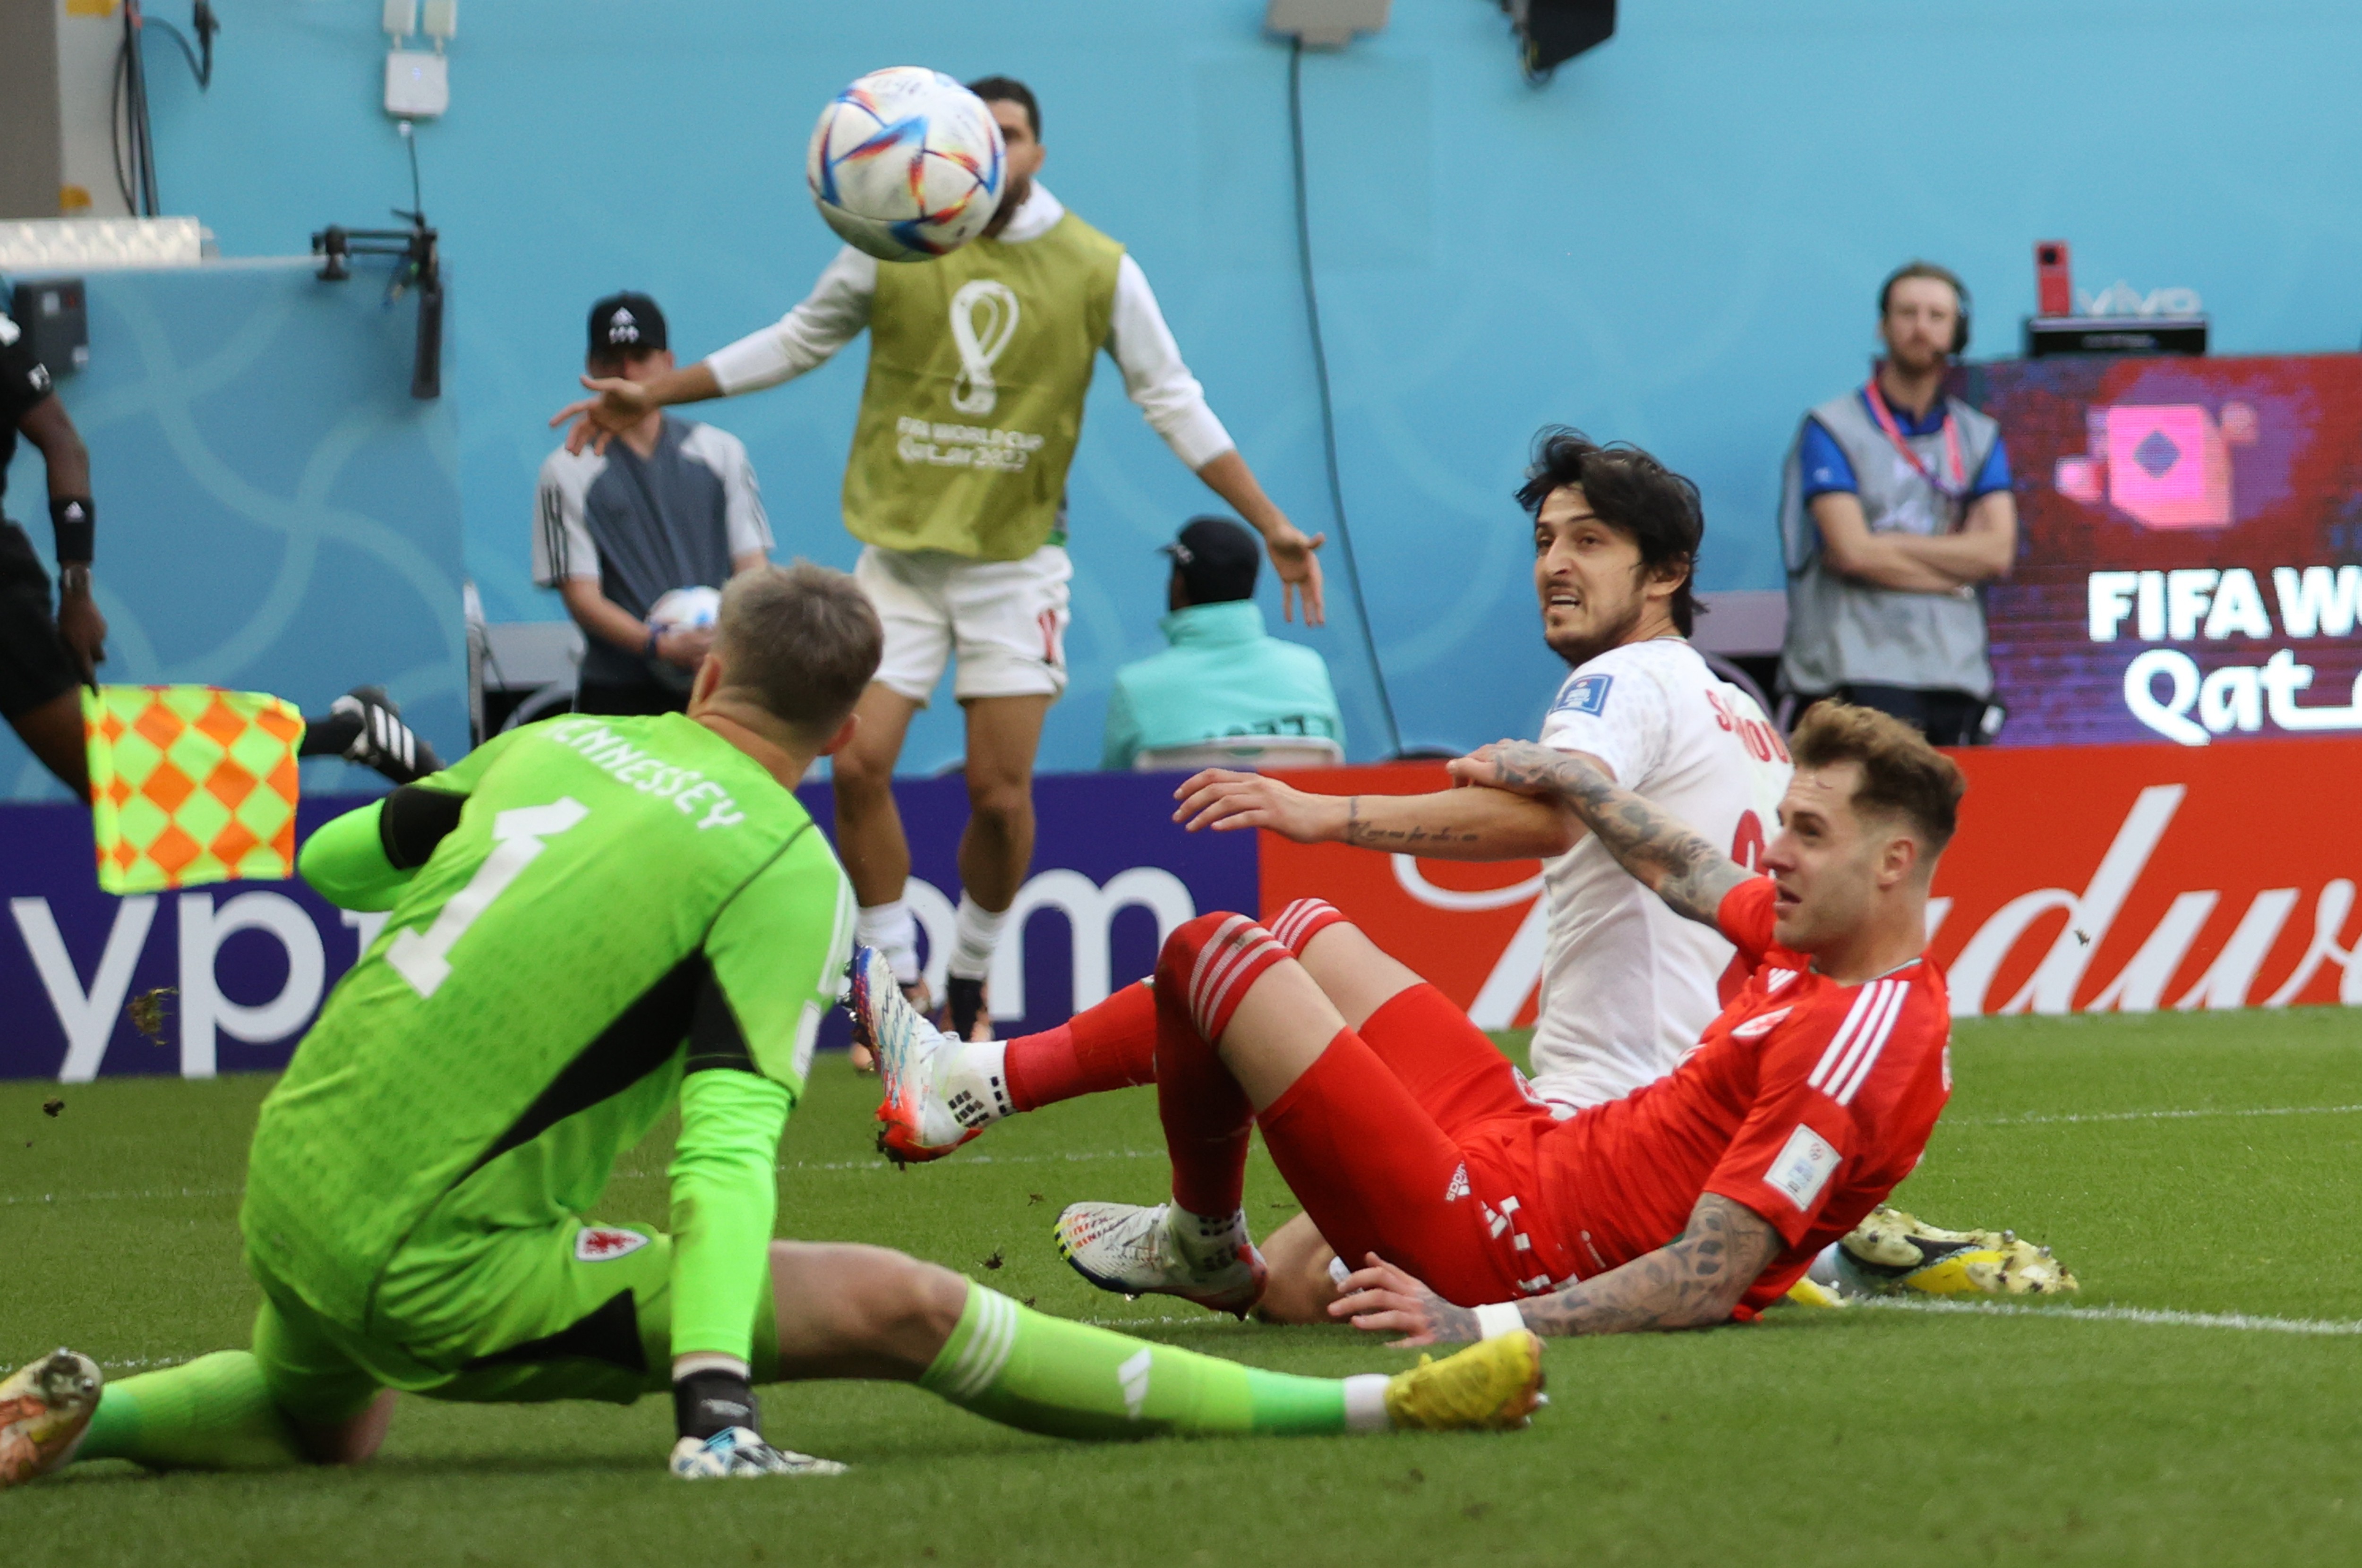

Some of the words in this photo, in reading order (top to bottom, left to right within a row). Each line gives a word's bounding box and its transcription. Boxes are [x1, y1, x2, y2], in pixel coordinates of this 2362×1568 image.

[2087, 568, 2273, 642] FIFA
[2271, 565, 2362, 639] W
[2124, 648, 2362, 746] Qat
[538, 718, 745, 830] ENNESSEY
[384, 796, 590, 999] 1
